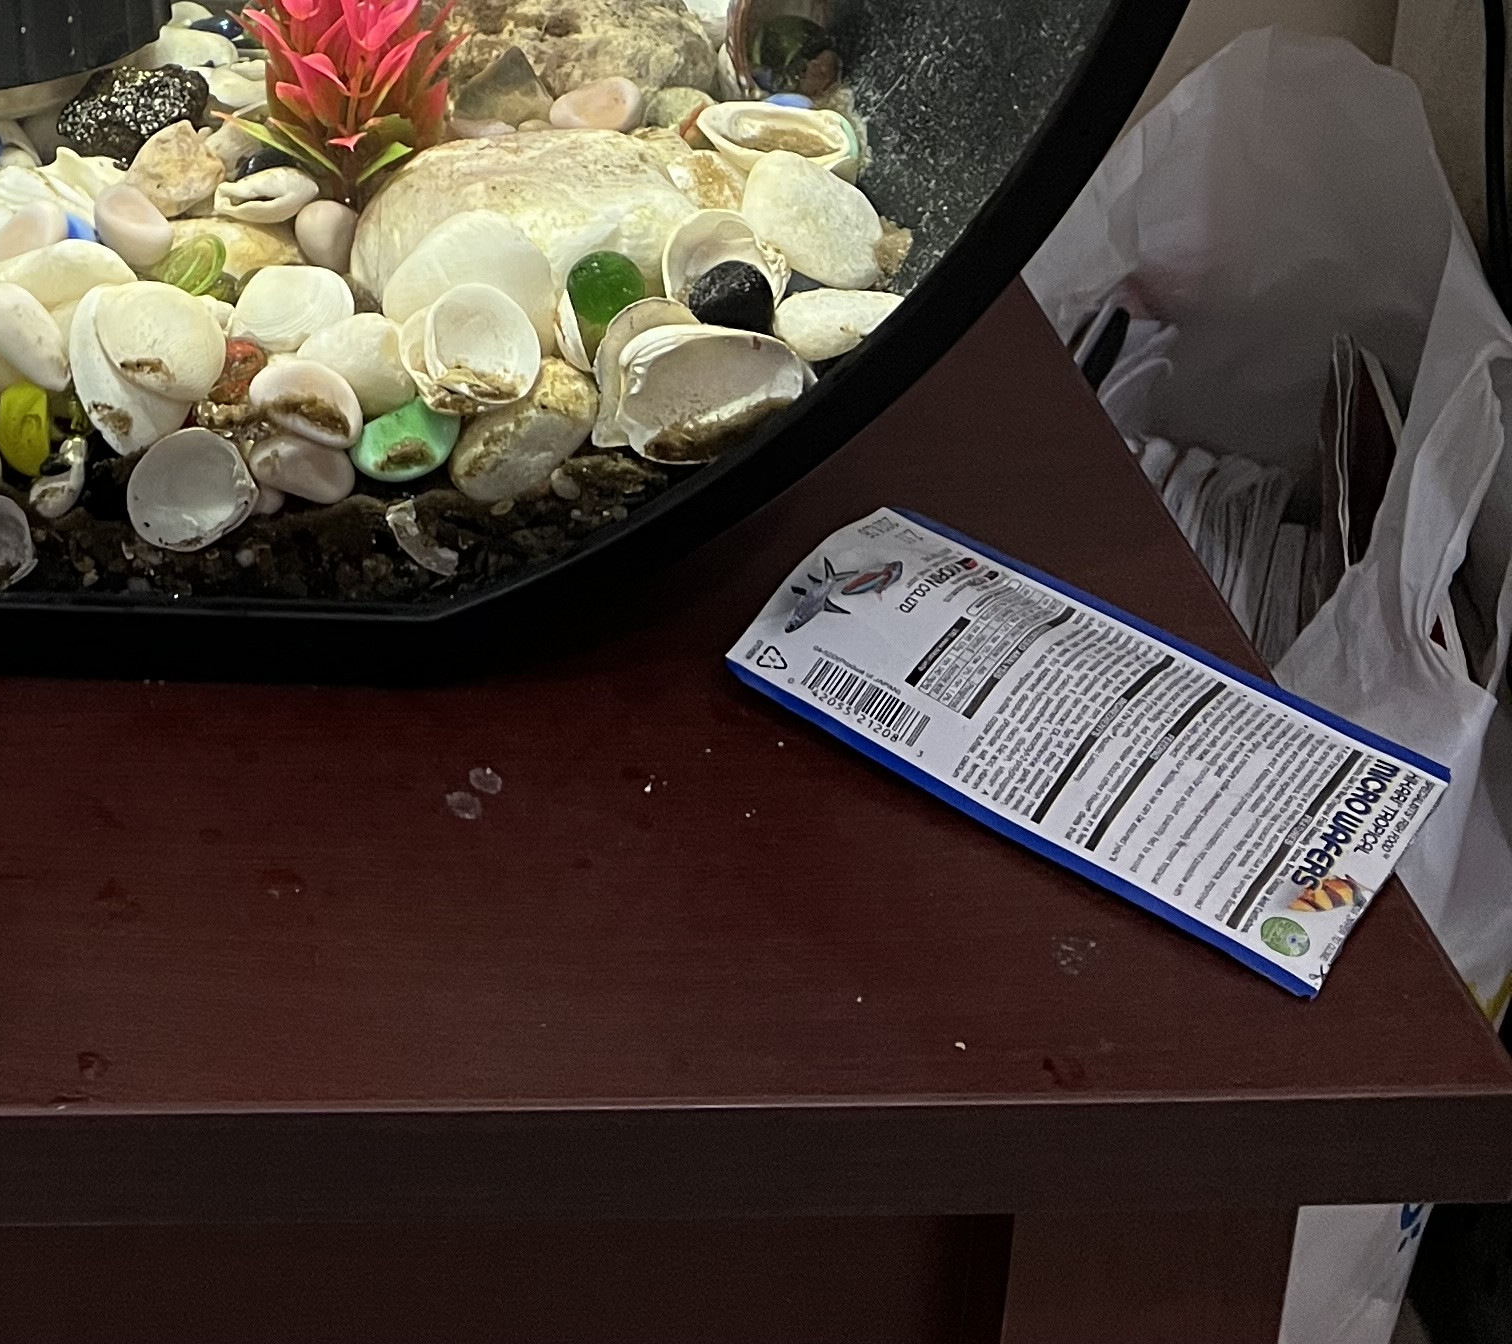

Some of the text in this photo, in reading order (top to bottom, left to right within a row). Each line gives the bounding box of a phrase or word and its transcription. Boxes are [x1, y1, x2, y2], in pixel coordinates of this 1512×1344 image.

[855, 713, 901, 743] 21208
[1344, 758, 1401, 817] MICRO
[1292, 810, 1364, 891] WAFERS
[1352, 805, 1398, 855] TROPICAL
